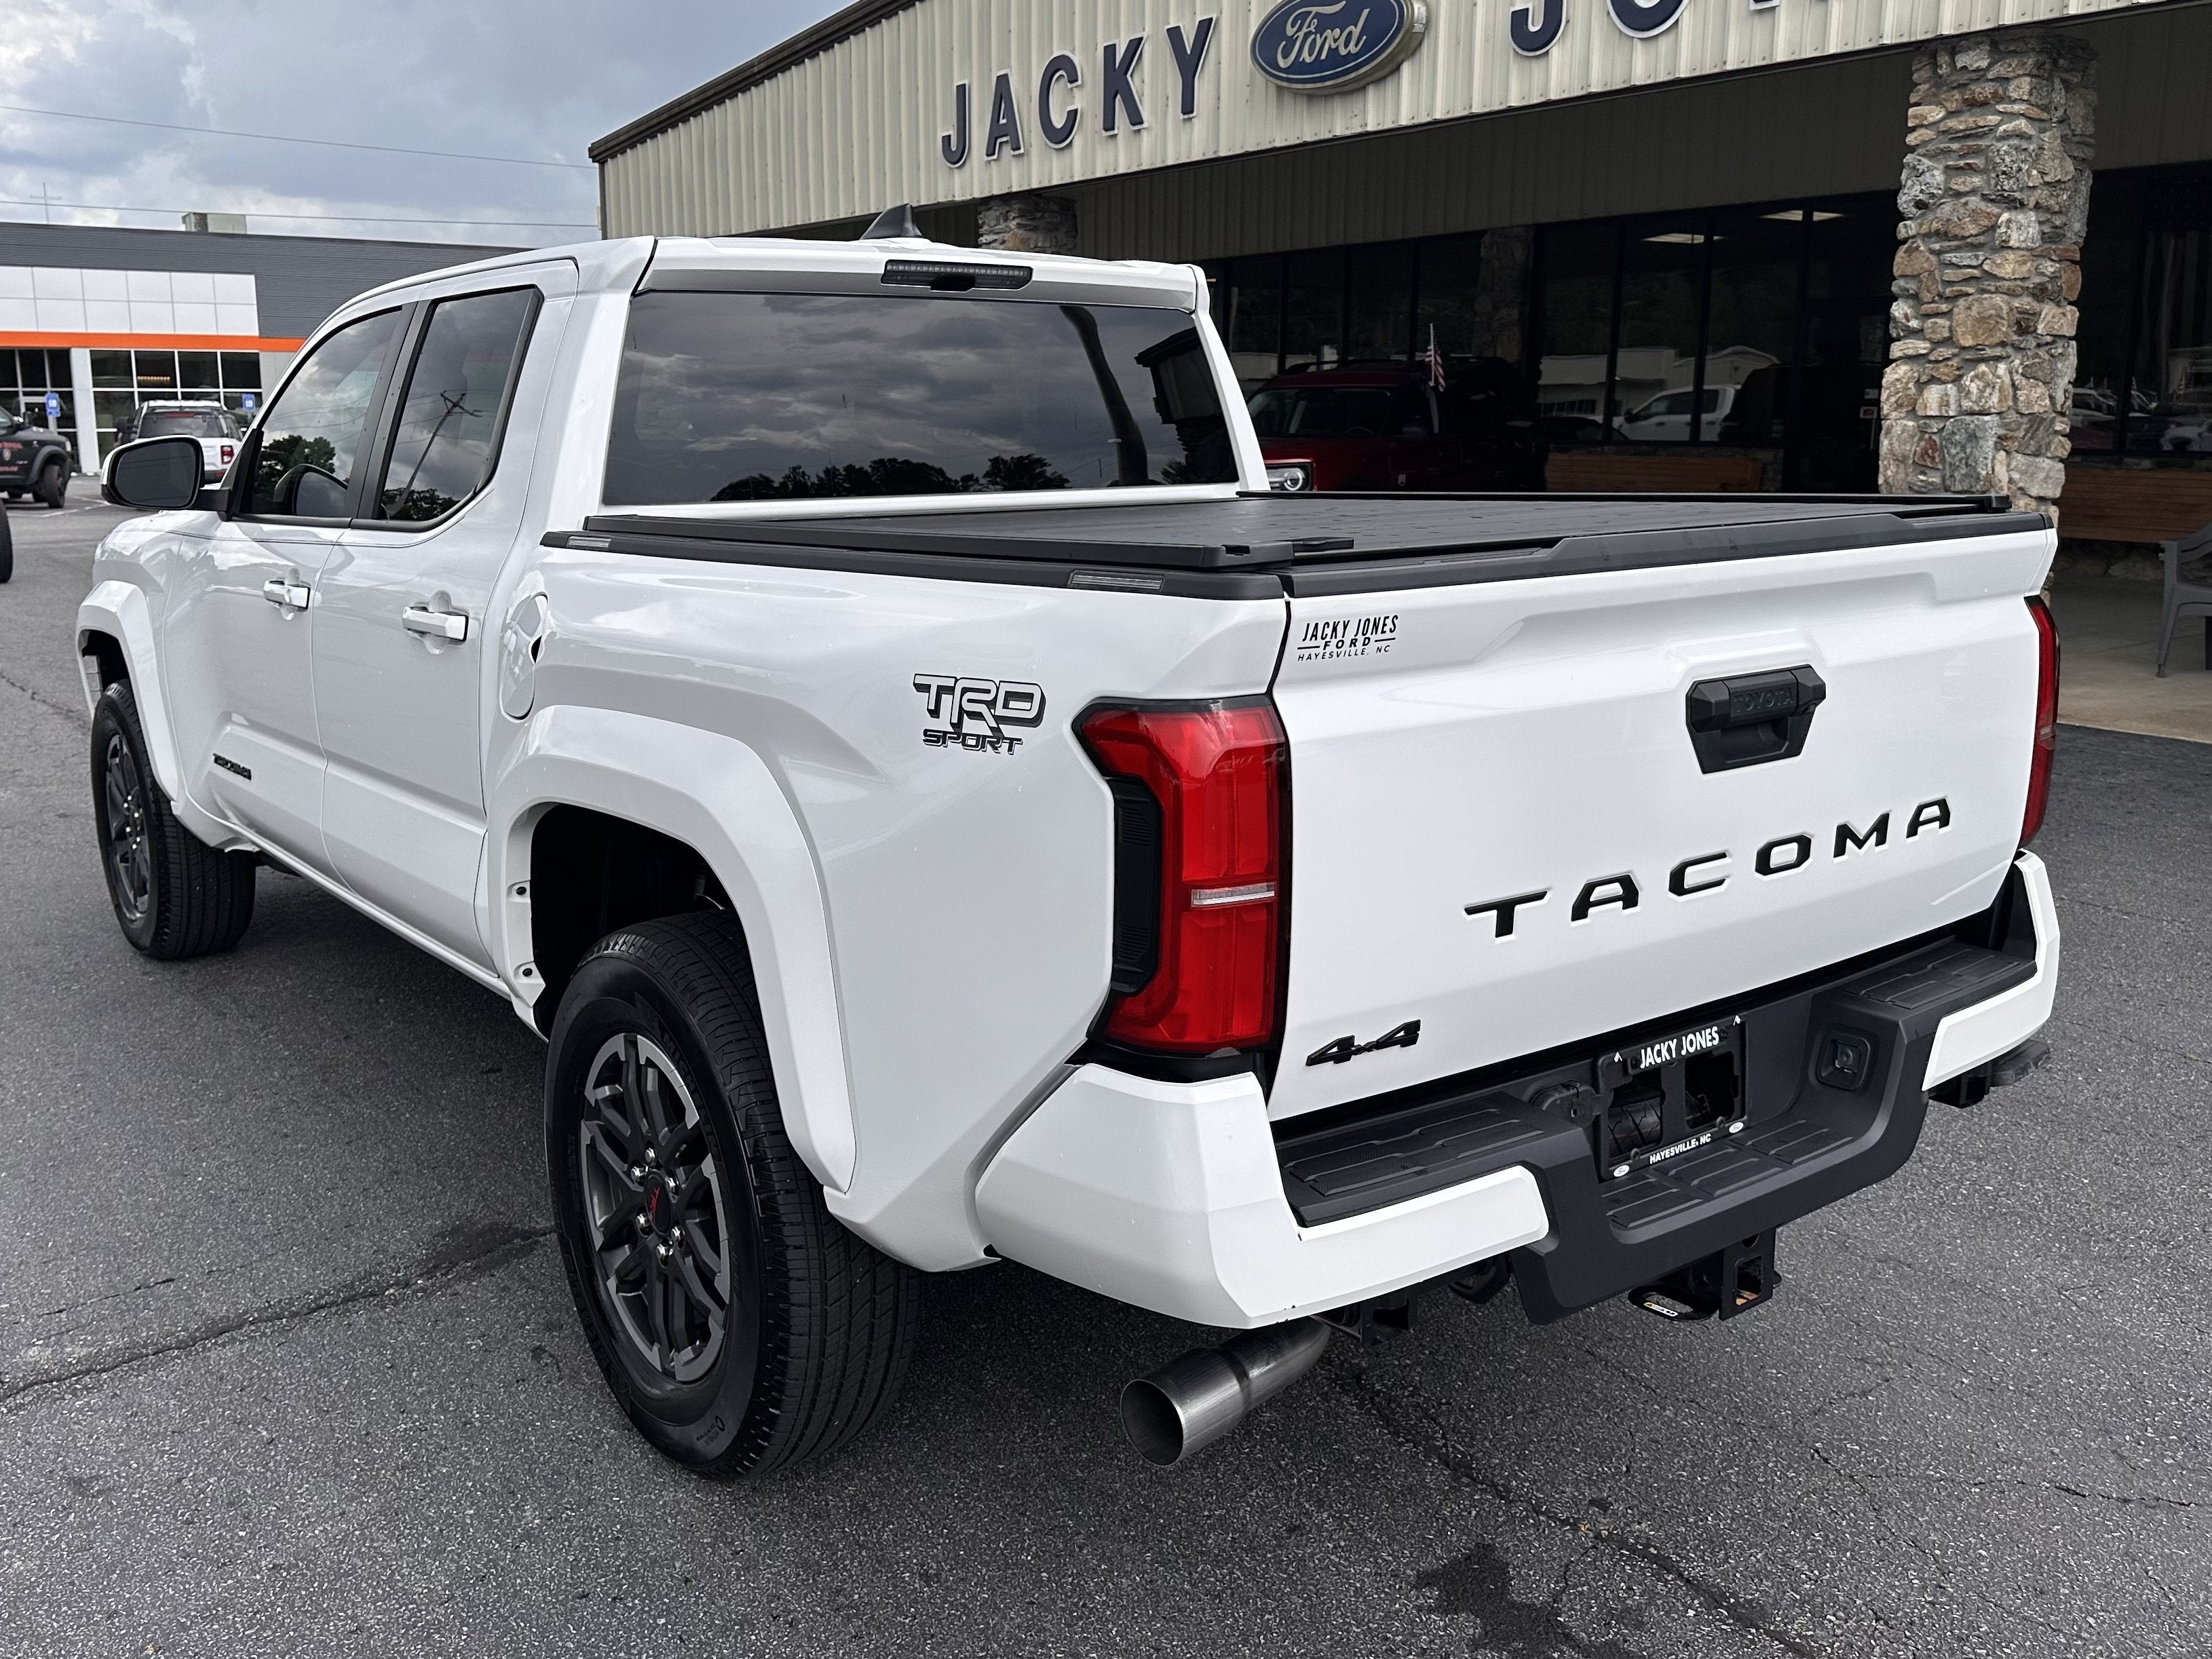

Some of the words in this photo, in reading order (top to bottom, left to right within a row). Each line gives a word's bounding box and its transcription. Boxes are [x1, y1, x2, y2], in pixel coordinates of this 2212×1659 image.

[1276, 0, 1371, 69] Ford
[941, 15, 1216, 168] JACKY
[1302, 619, 1350, 642] JACKY
[1354, 615, 1398, 638] JONES
[1322, 636, 1371, 651] FORD
[1375, 645, 1391, 654] NC
[913, 672, 1047, 738] TRD
[1732, 687, 1795, 713] TOYOTA
[921, 727, 1024, 756] SPORT
[212, 752, 252, 781] TACOMA
[1464, 797, 1951, 939] TACOMA
[1639, 1038, 1678, 1069] JACKY
[1681, 1026, 1719, 1056] JONES
[1700, 1133, 1711, 1145] NC
